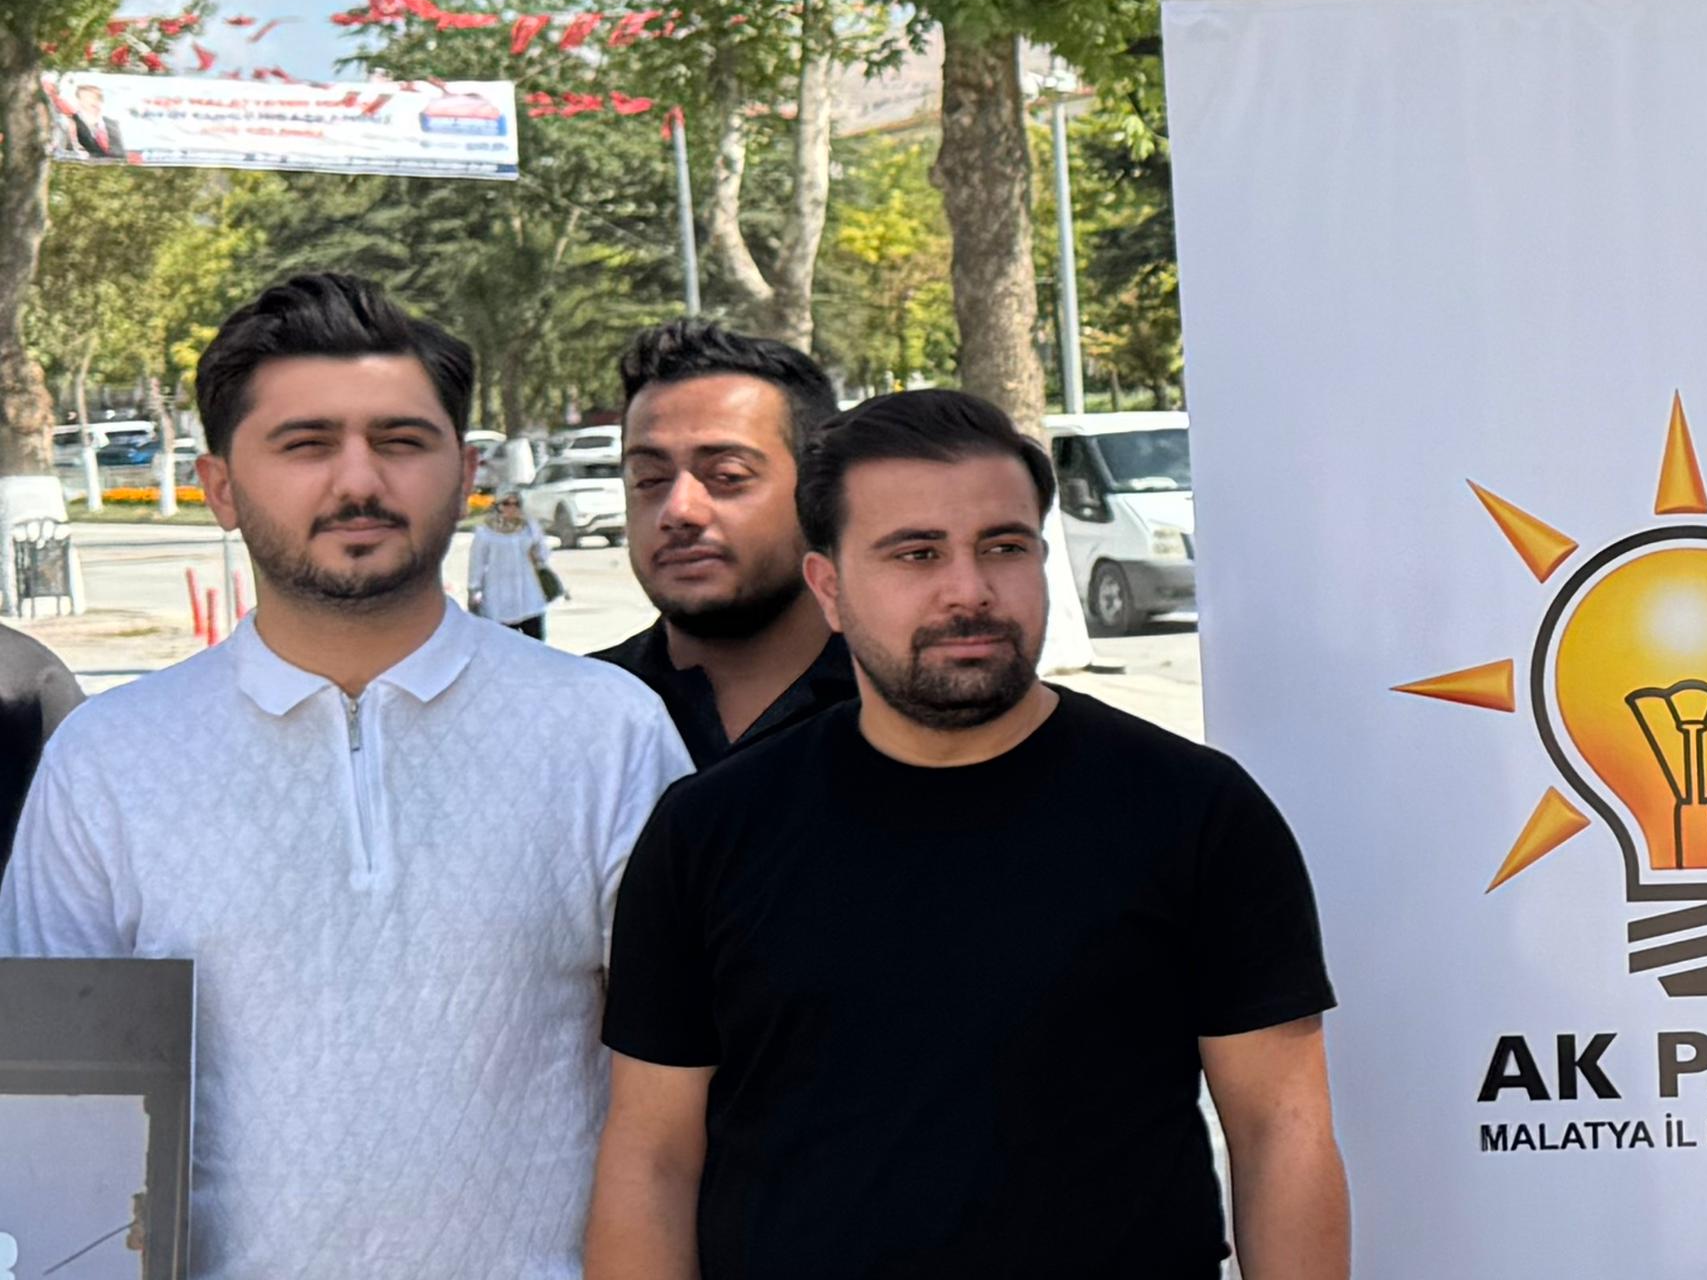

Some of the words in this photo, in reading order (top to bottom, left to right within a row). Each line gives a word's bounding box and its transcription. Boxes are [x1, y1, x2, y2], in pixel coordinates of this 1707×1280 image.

[1477, 1033, 1622, 1102] AK
[1481, 1122, 1655, 1153] MALATYA
[1666, 1114, 1697, 1148] İL
